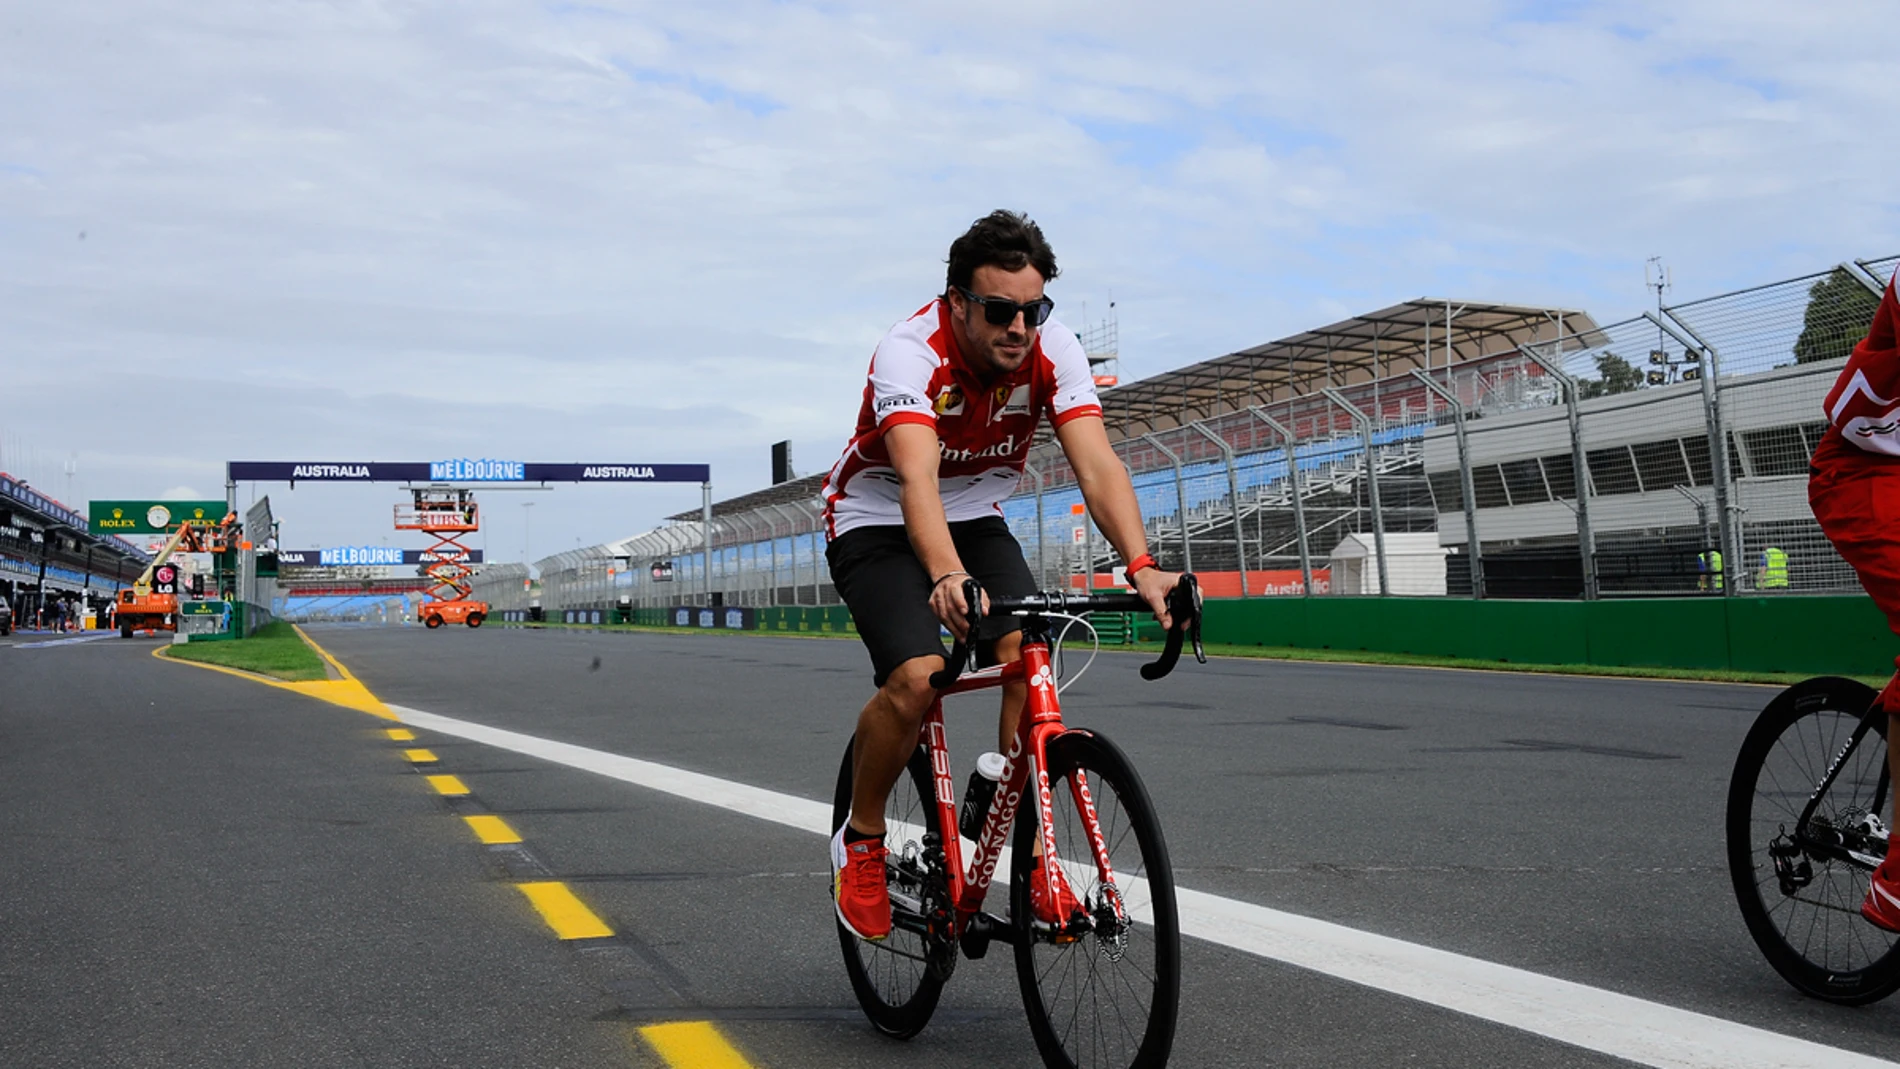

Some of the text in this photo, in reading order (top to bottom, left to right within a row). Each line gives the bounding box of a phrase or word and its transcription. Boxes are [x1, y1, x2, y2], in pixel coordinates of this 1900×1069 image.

[292, 461, 655, 480] AUSTRALIA MELBOURNE AUSTRALIA
[99, 519, 136, 528] ROLEX
[430, 514, 460, 526] UBS
[320, 547, 402, 565] MELBOURNE
[157, 584, 173, 593] LG
[978, 791, 1019, 889] COLNAGO
[1039, 770, 1061, 894] COLNAGO
